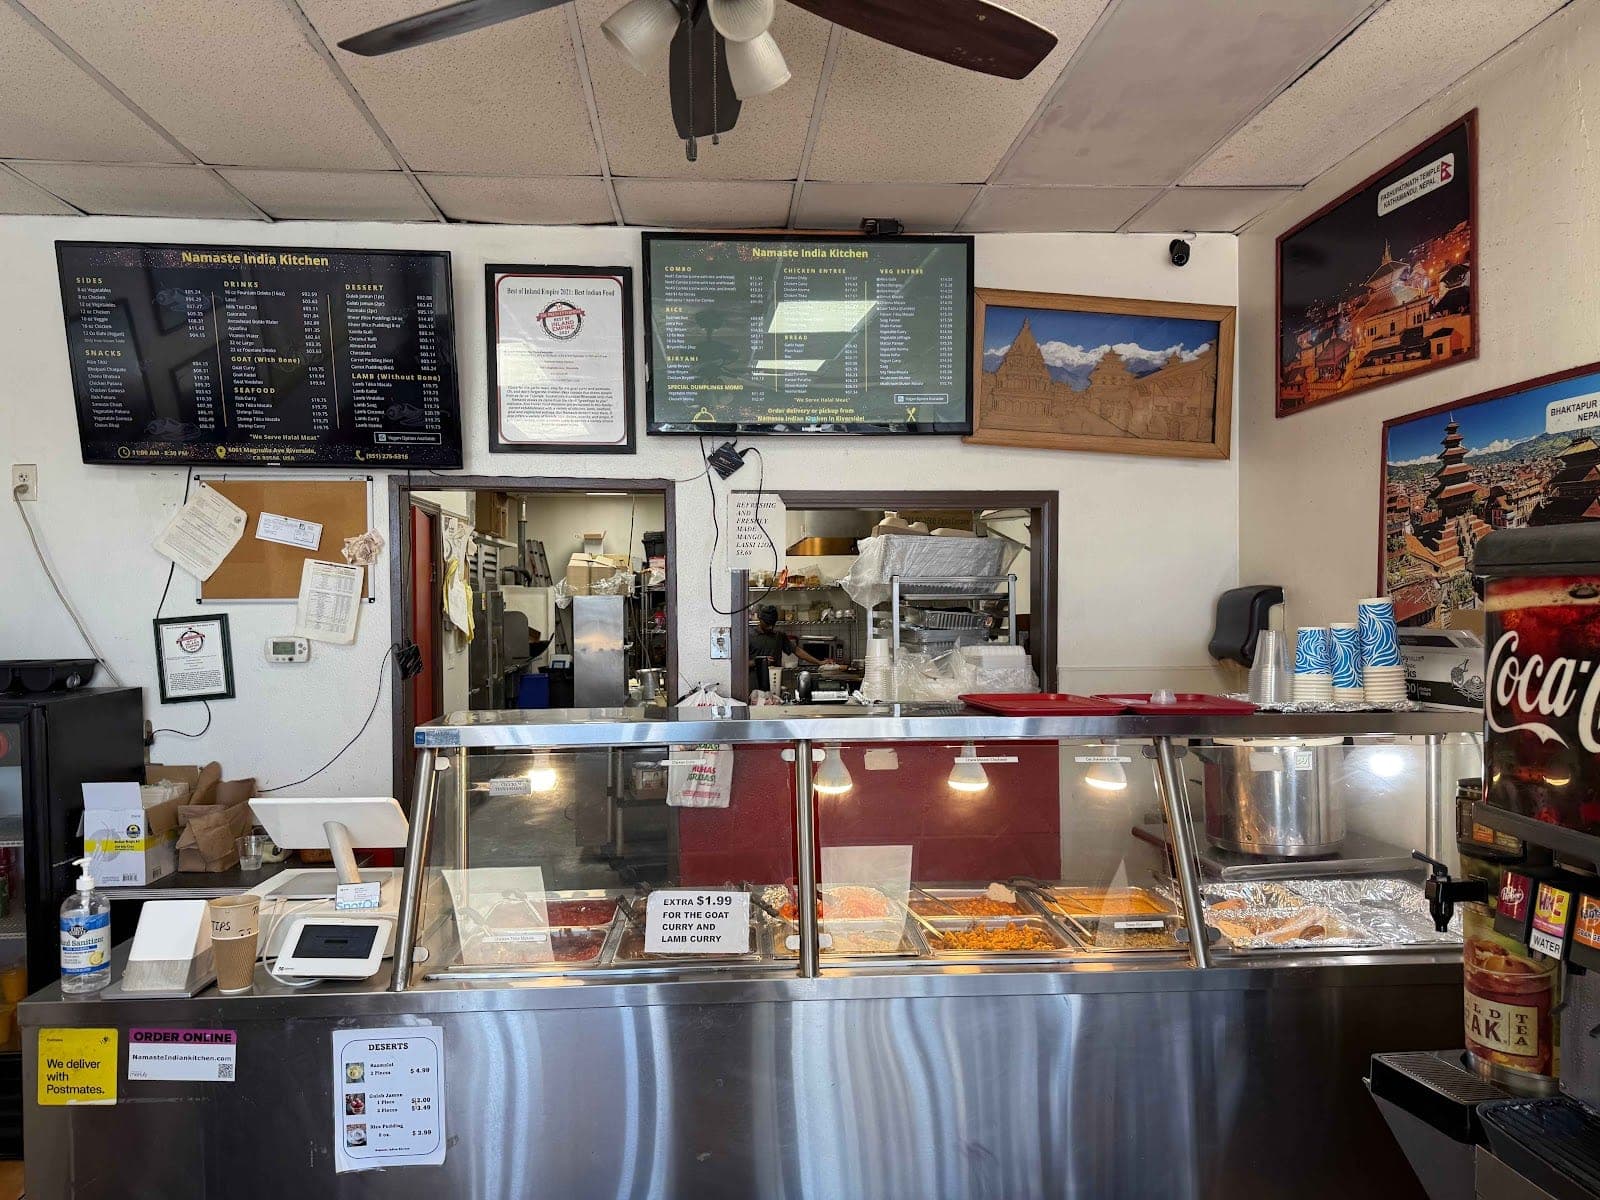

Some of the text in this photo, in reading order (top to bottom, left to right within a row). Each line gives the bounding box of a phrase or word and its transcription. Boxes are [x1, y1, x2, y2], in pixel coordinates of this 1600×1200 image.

[1420, 165, 1441, 181] TEMPLE
[1419, 177, 1436, 191] NEPAL
[182, 251, 329, 267] Namaste India Kitchen
[752, 249, 868, 258] Namaste India Kitchen
[1551, 400, 1598, 417] BHAKTAPUR
[1578, 411, 1600, 422] NEPA
[697, 896, 732, 906] $1.99
[211, 920, 231, 932] TIPS
[1534, 935, 1560, 954] WATER
[1515, 1014, 1528, 1046] TEA
[134, 1032, 232, 1043] ORDER ONLINE
[368, 1043, 409, 1051] DESERTS
[133, 1054, 232, 1062] NamasteIndiankitchen.com
[47, 1059, 101, 1069] We deliver
[47, 1072, 69, 1082] with
[47, 1084, 105, 1095] Postmates.
